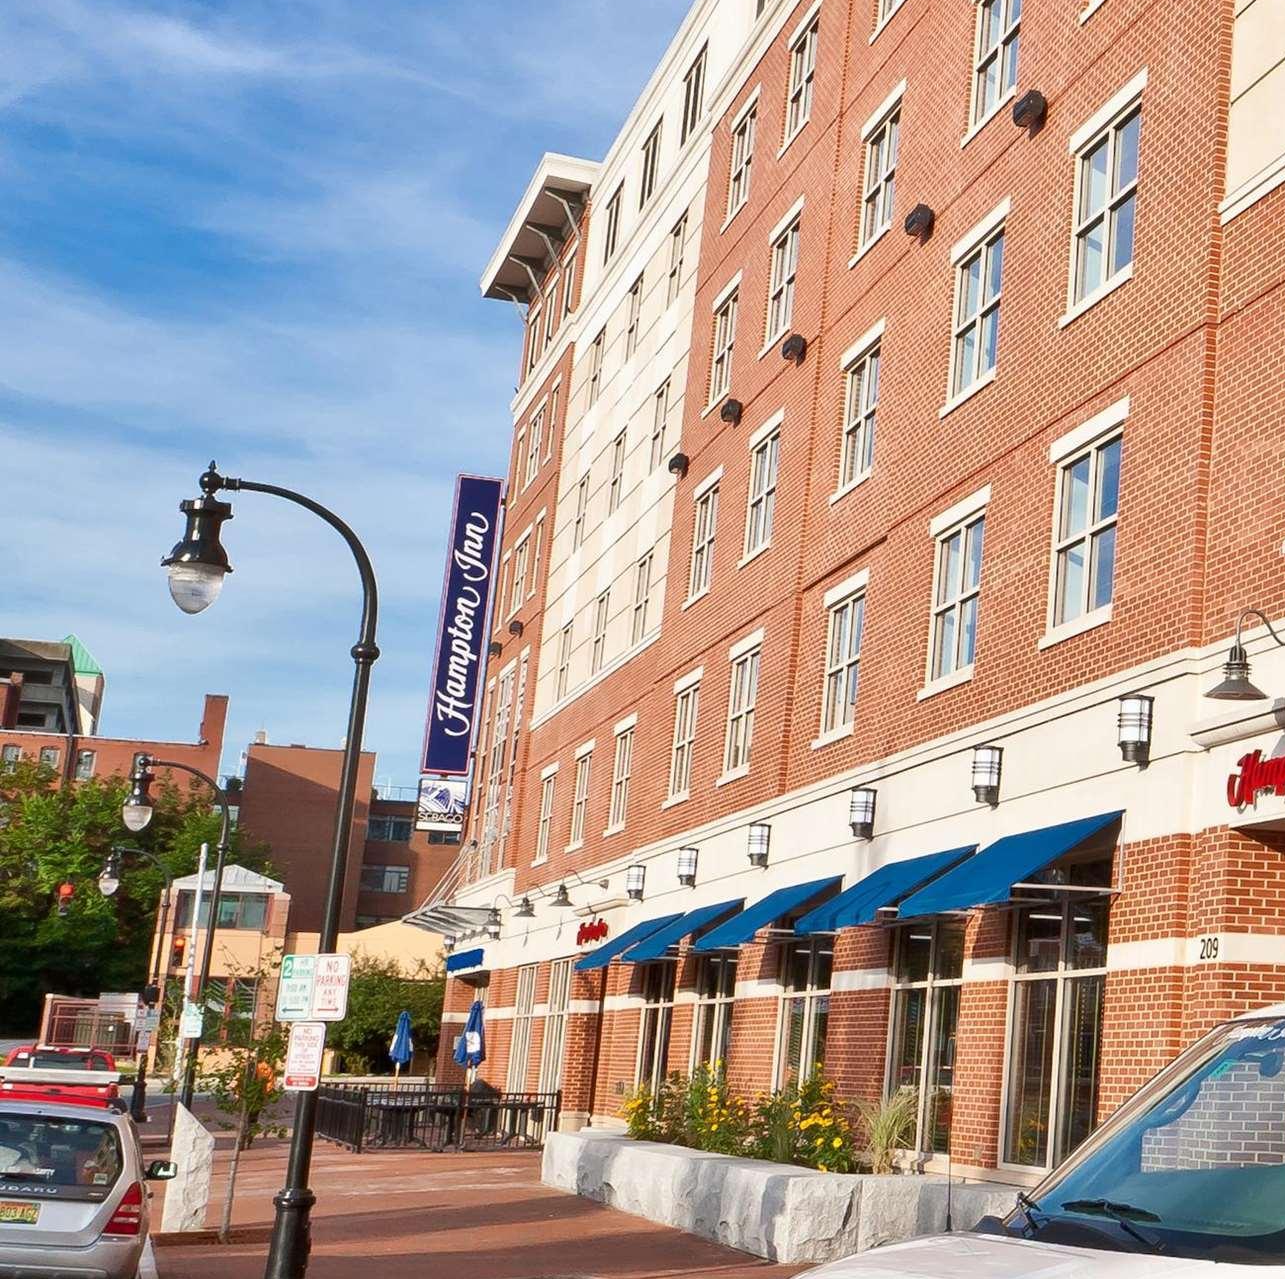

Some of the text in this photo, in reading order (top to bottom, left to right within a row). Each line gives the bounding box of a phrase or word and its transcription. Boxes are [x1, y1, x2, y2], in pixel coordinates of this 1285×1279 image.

[436, 511, 489, 737] Hampton Inn
[417, 811, 463, 825] SEBAGO
[1199, 937, 1219, 960] 209
[283, 959, 293, 977] 2
[326, 960, 340, 973] NO
[316, 975, 346, 986] PARKING
